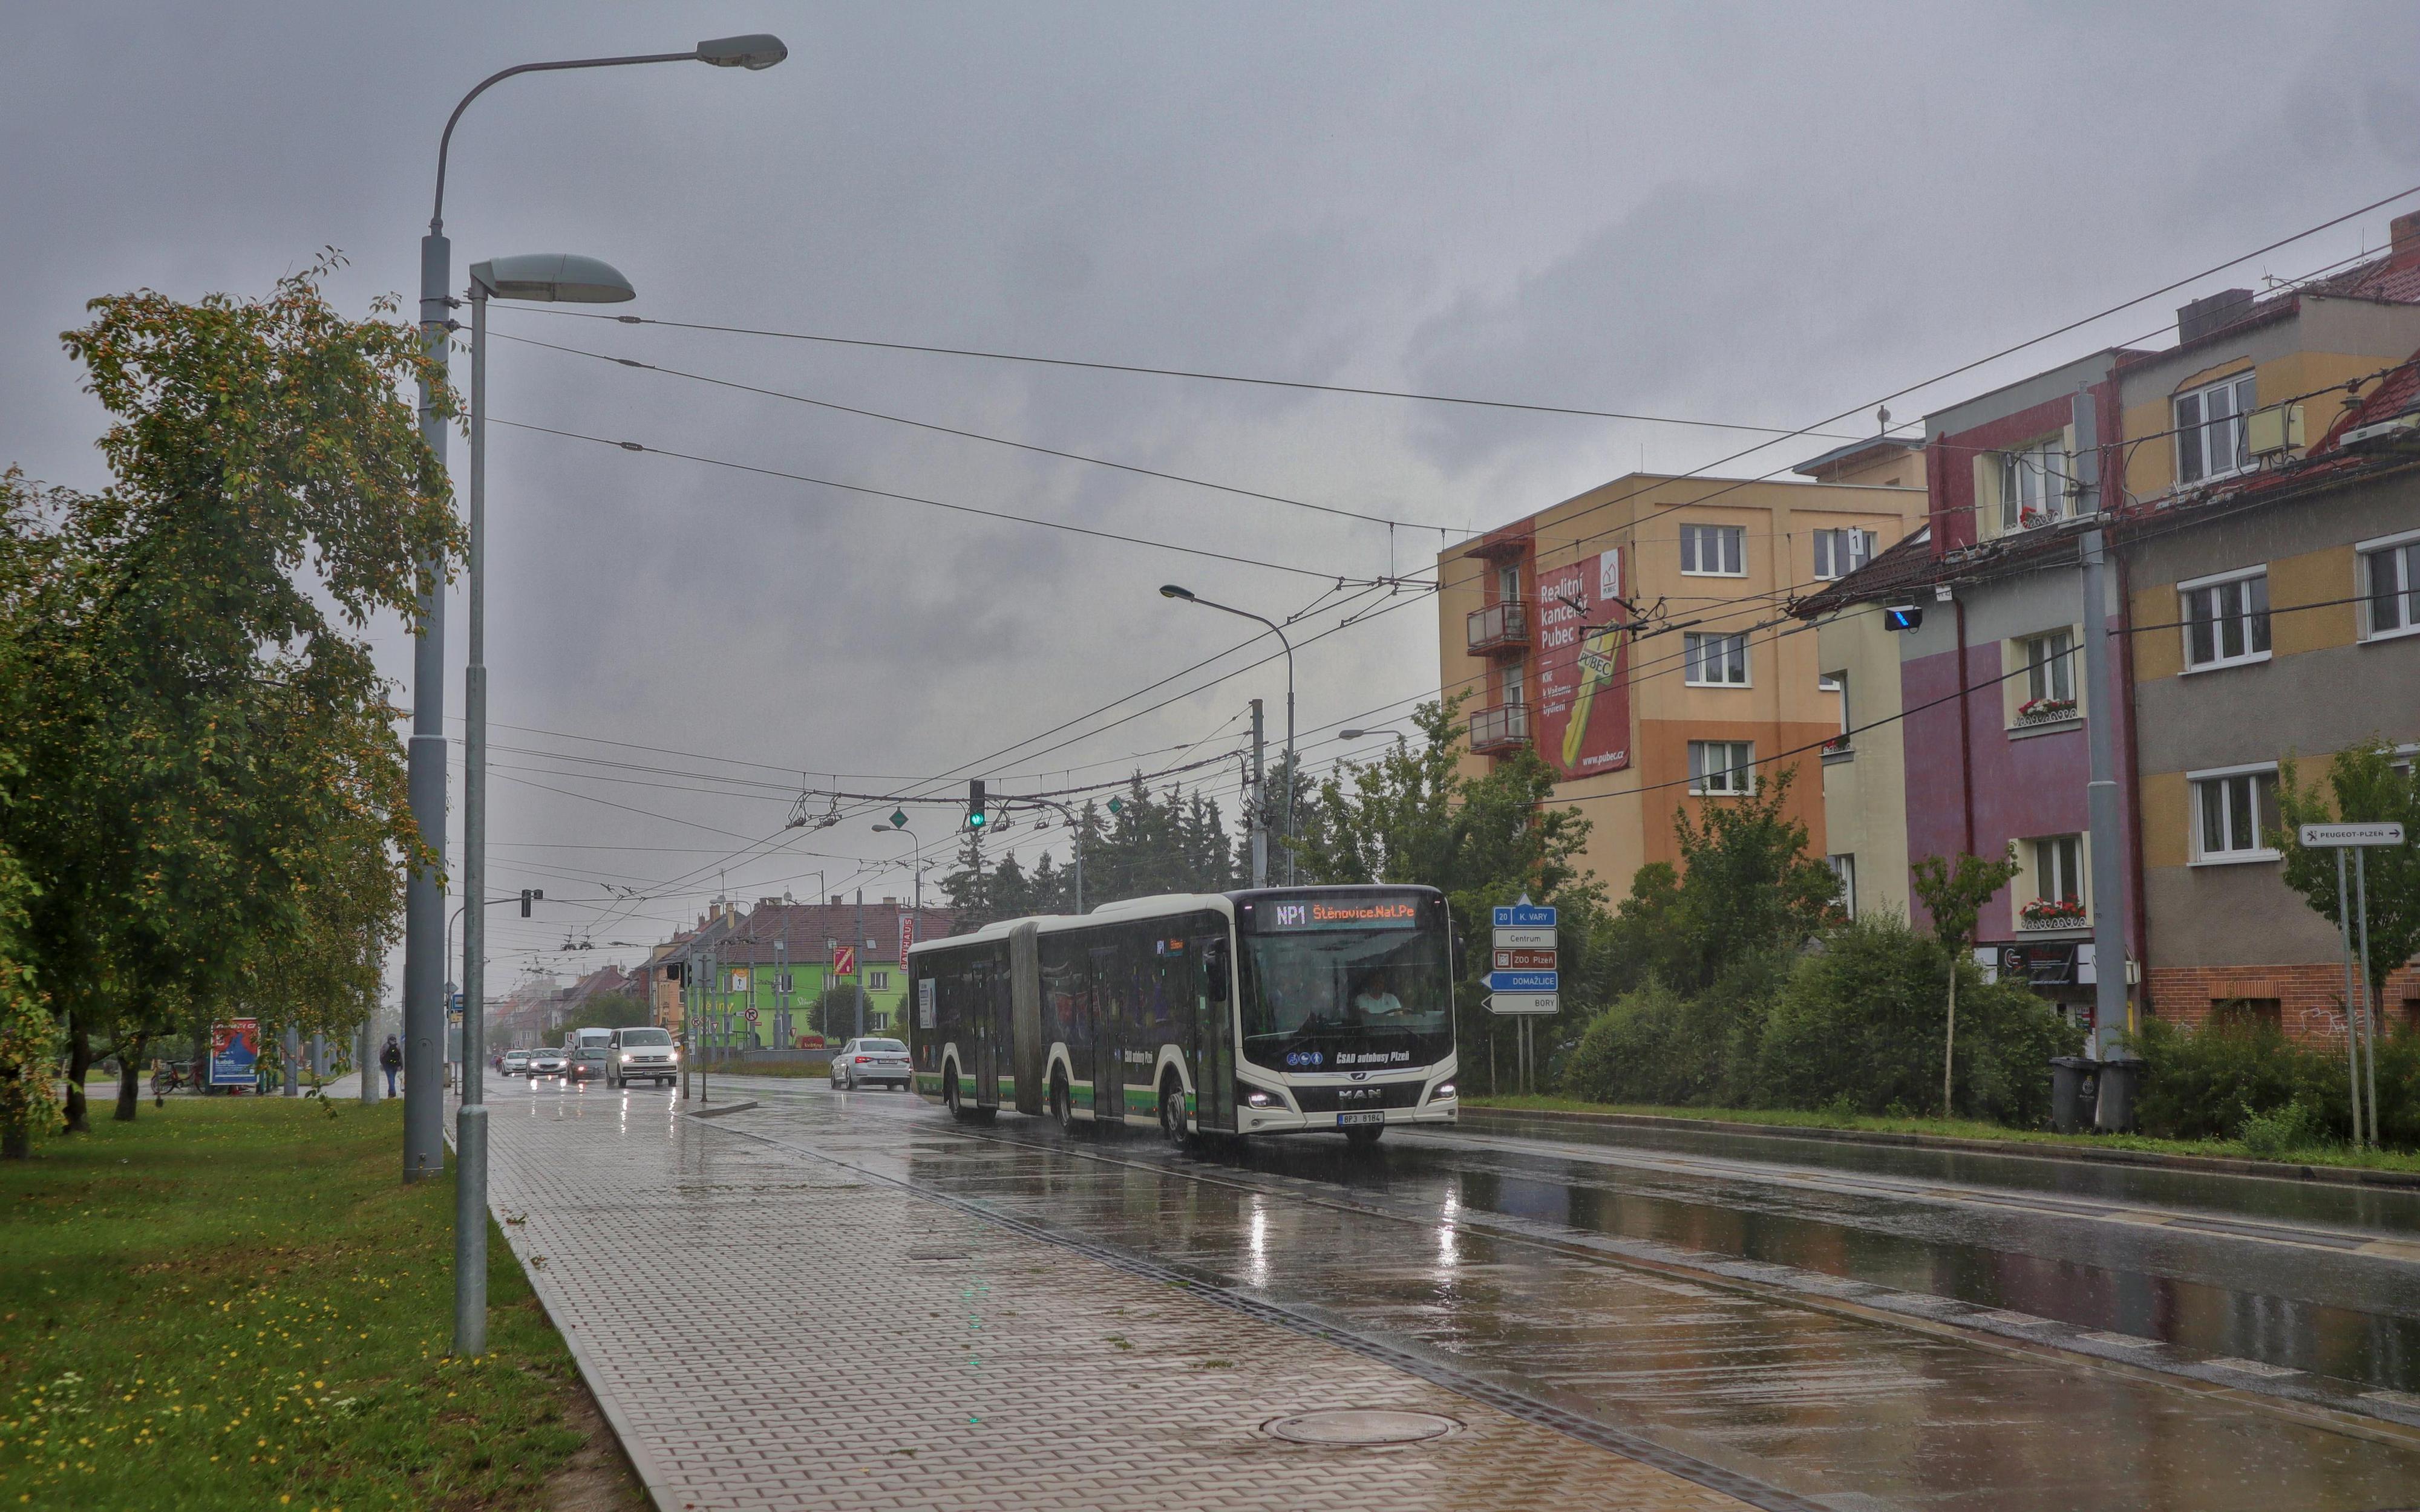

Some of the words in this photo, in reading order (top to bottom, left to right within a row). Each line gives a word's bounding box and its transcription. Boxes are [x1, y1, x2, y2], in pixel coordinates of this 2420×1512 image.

[1853, 535, 1858, 549] 1
[1541, 572, 1583, 604] Realitní
[1542, 626, 1574, 649] Pubec
[1579, 652, 1612, 676] PUBEC
[1583, 751, 1624, 766] www.pubec.cz
[1277, 905, 1306, 925] NP1
[901, 919, 912, 970] BAUHAUS
[1513, 976, 1555, 985] DOMAŽLICE
[1336, 1052, 1356, 1064] ČSAD
[1357, 1052, 1390, 1063] autobusy
[1390, 1051, 1410, 1061] Plzeň
[1339, 1089, 1381, 1100] MAN
